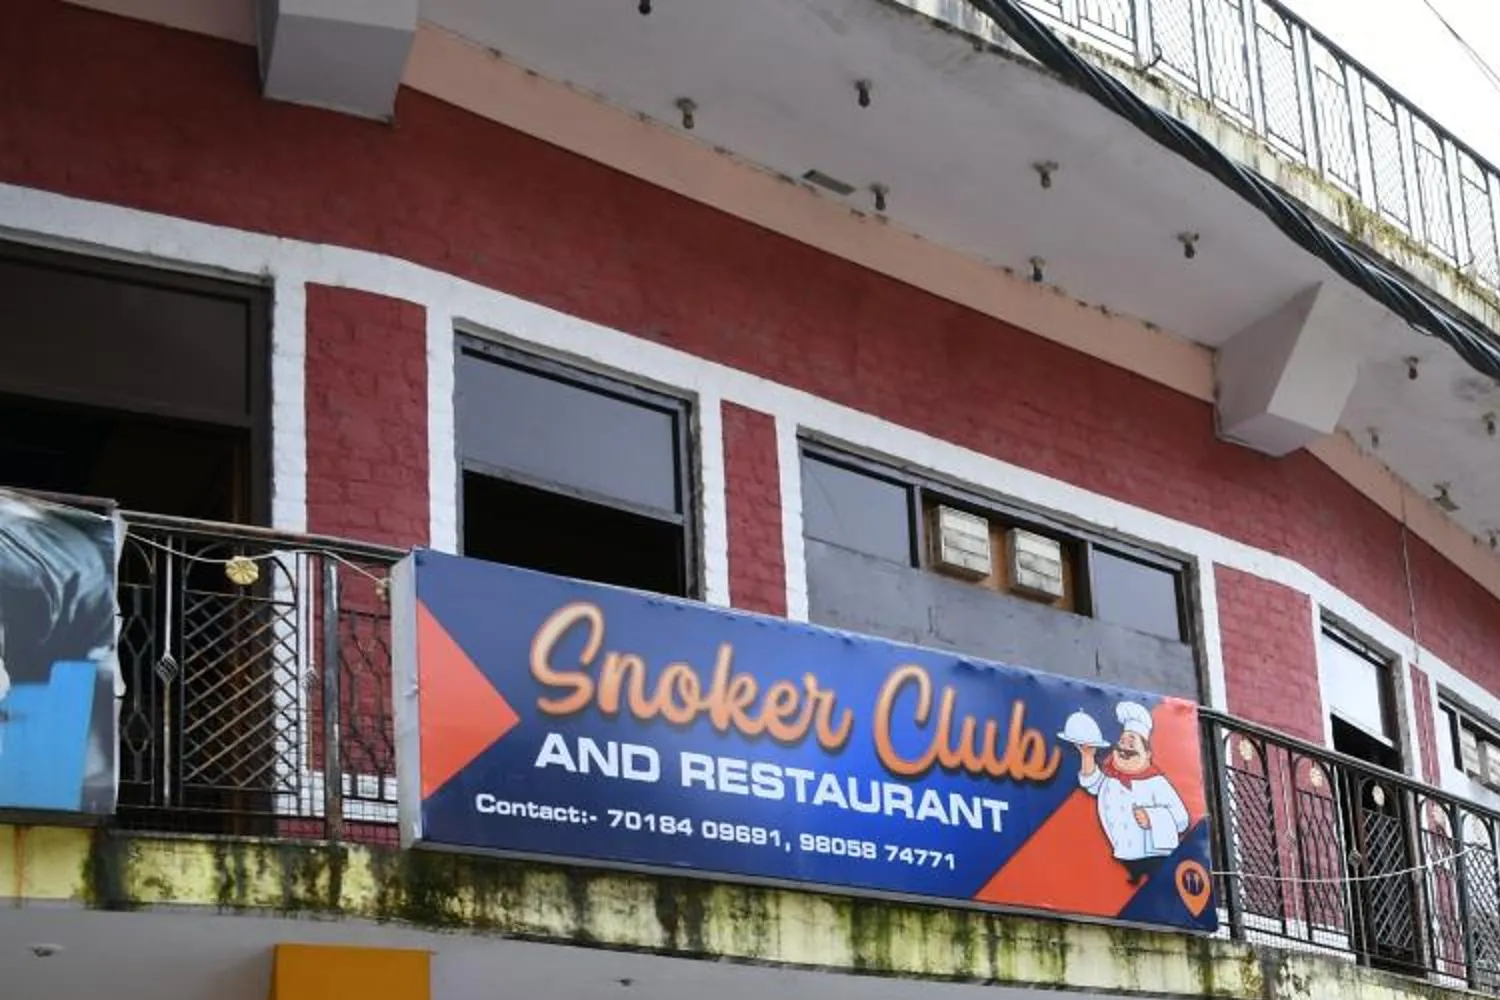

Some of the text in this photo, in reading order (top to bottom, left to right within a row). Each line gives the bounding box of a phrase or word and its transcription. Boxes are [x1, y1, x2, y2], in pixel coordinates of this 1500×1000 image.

[530, 601, 1063, 781] Snoker Club
[475, 793, 598, 825] Contact:-
[607, 809, 693, 837] 70184
[884, 844, 956, 871] 74771
[534, 732, 1009, 833] AND RESTAURANT
